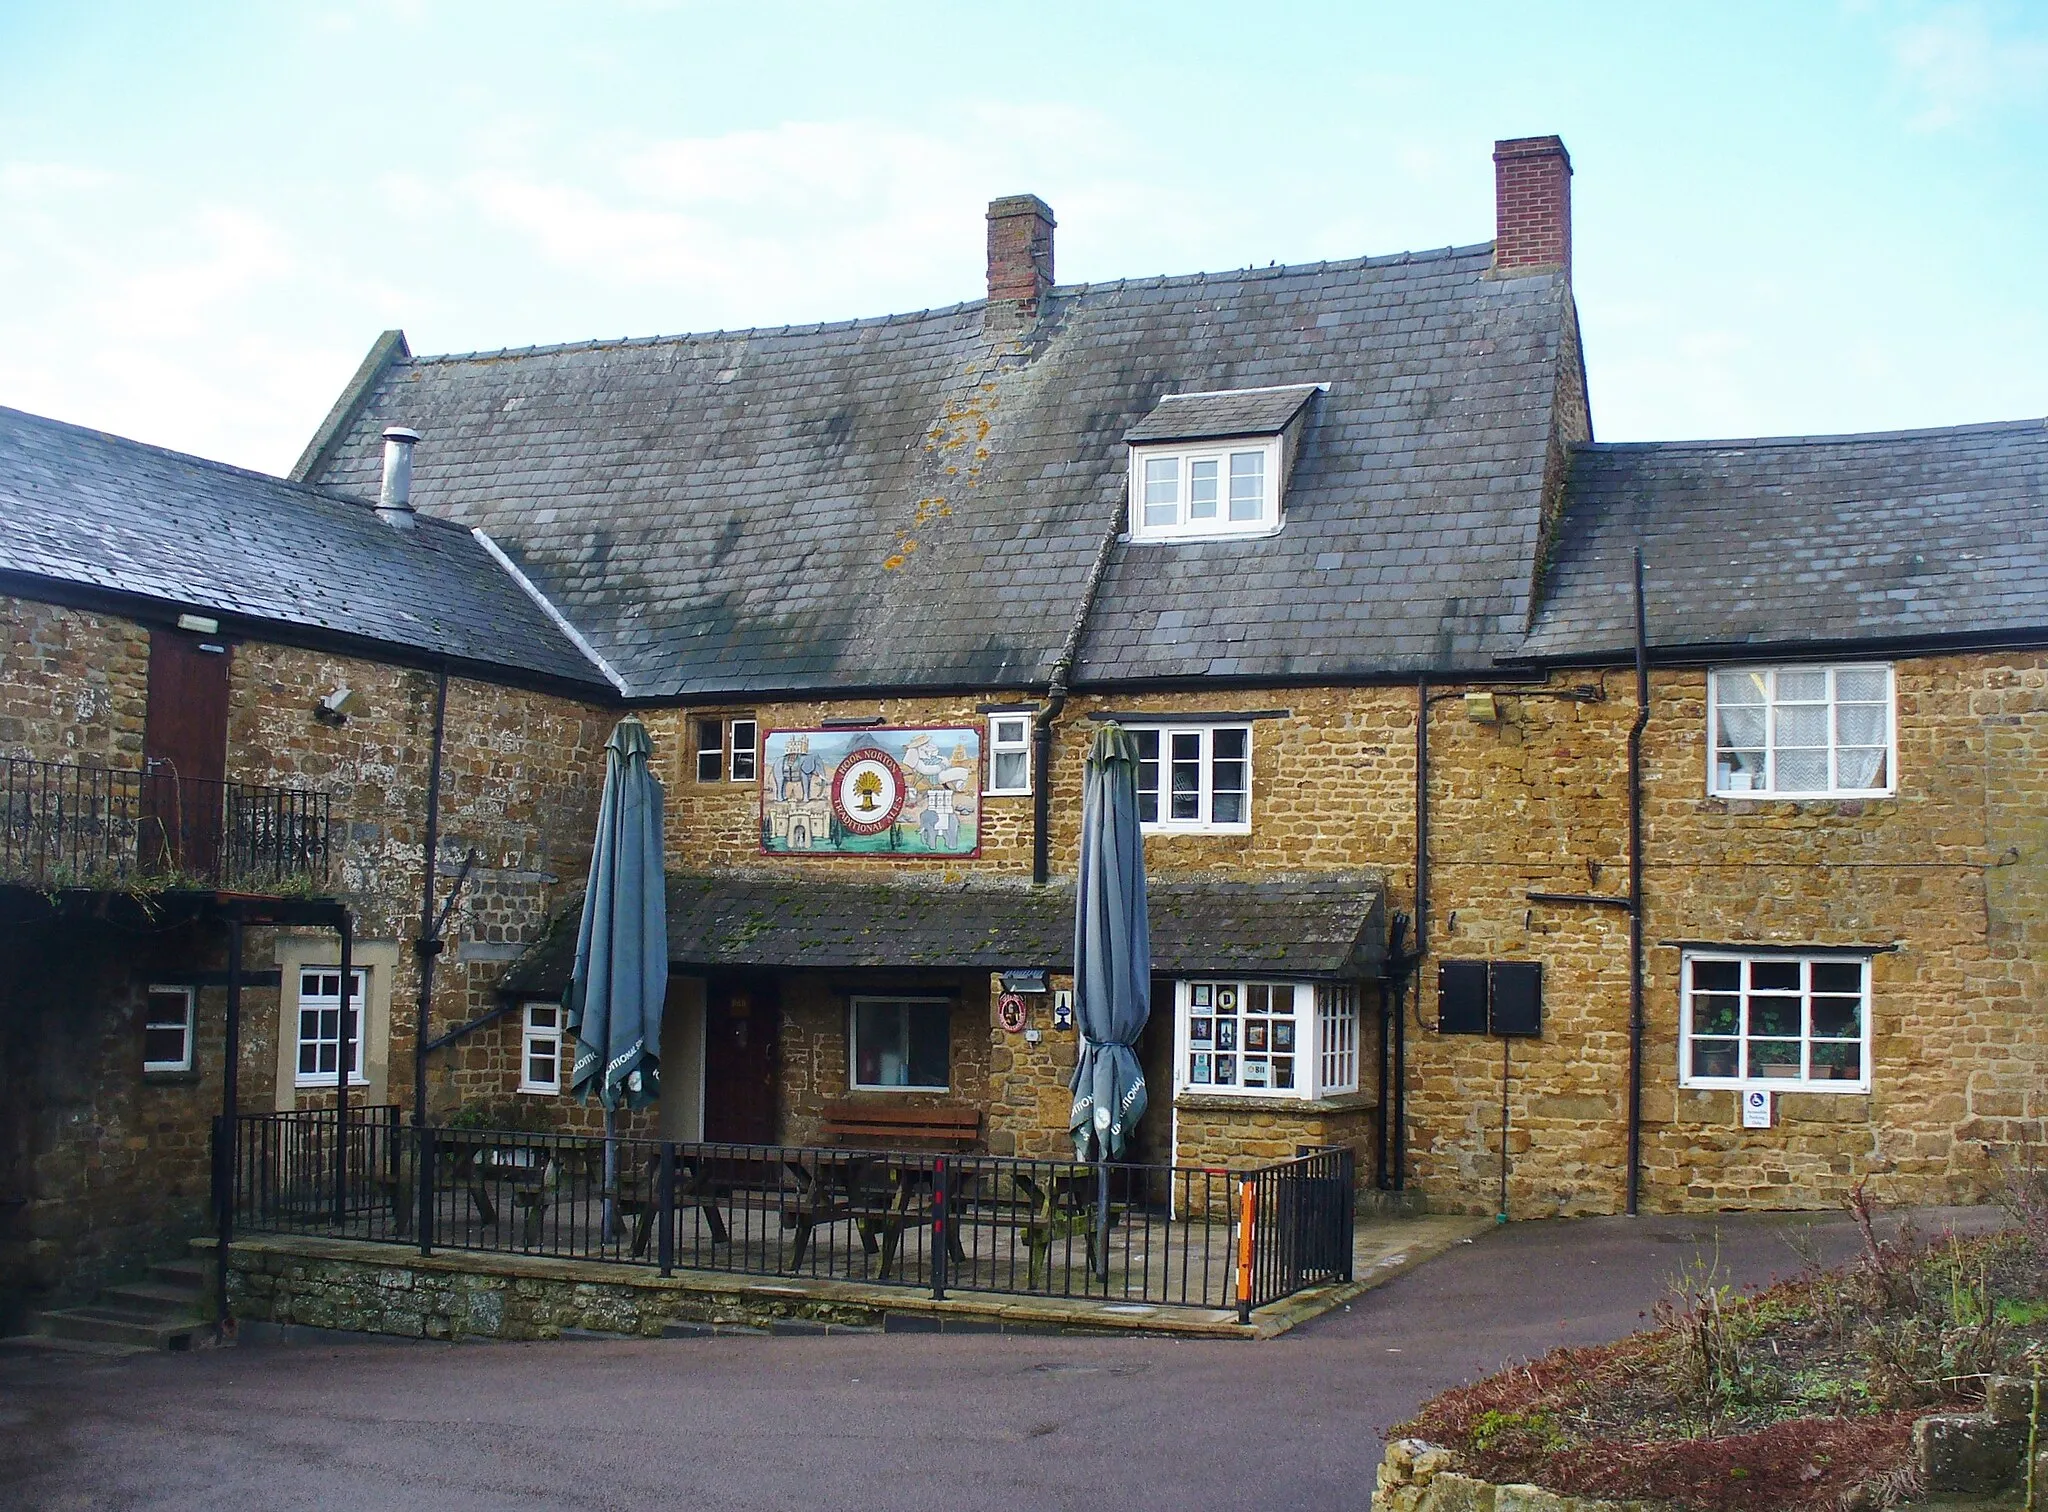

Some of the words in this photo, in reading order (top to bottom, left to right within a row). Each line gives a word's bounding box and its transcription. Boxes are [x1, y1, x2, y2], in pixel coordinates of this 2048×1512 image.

[838, 751, 861, 774] HOOK
[864, 750, 899, 773] NORTON
[834, 799, 882, 833] TRADITIONAL
[887, 796, 903, 824] ALES
